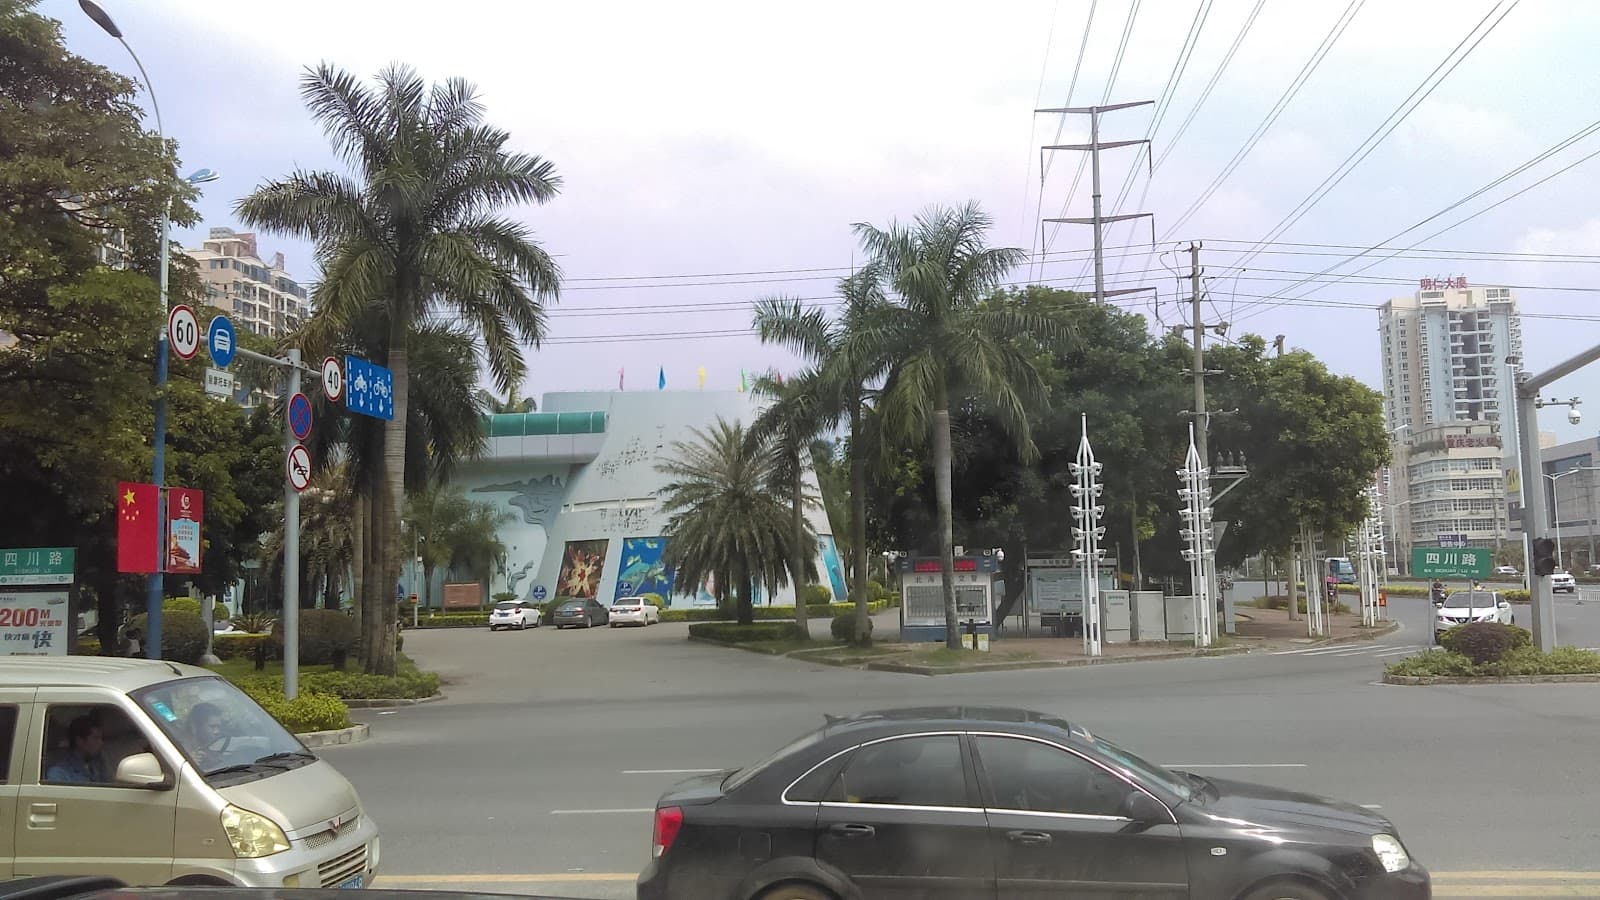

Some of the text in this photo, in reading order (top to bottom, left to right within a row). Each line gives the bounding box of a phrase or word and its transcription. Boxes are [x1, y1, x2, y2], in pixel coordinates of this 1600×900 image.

[1420, 276, 1466, 290] 明仁大厦
[176, 319, 194, 346] 60
[327, 369, 339, 390] 40
[5, 552, 62, 566] 四川路
[1426, 552, 1477, 566] 四川路
